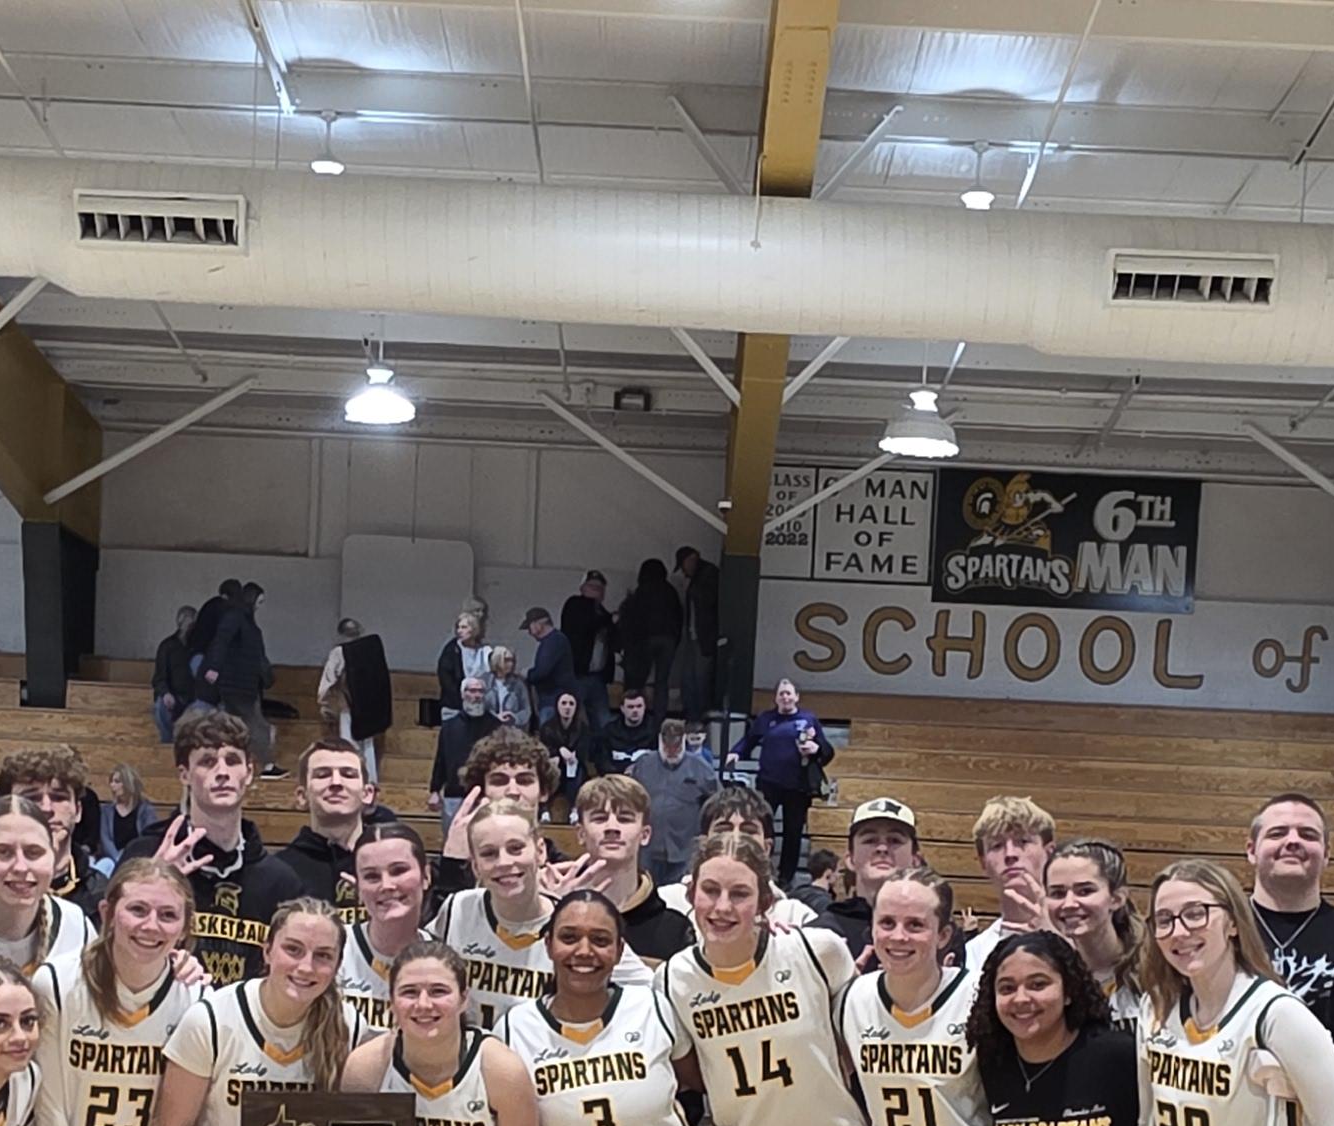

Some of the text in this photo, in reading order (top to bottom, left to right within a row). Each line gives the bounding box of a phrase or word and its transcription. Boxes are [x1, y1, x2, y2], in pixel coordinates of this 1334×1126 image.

[774, 473, 811, 487] LASS
[776, 490, 797, 501] OF
[865, 478, 929, 500] MAN
[835, 503, 916, 526] HALL
[1093, 490, 1175, 541] 6TH
[765, 532, 809, 546] 2022
[854, 530, 895, 547] OF
[825, 552, 918, 575] FAME
[946, 553, 1071, 594] SPARTANS
[1075, 541, 1187, 597] MAN
[793, 602, 1205, 690] SCHOOL
[1252, 625, 1329, 693] of
[468, 960, 554, 999] PARTAN
[692, 991, 800, 1039] SPARTANS
[69, 1038, 167, 1076] SPARTAN
[534, 1051, 647, 1096] SPARTANS
[725, 1039, 794, 1097] 14
[860, 1043, 963, 1075] SPARTANS
